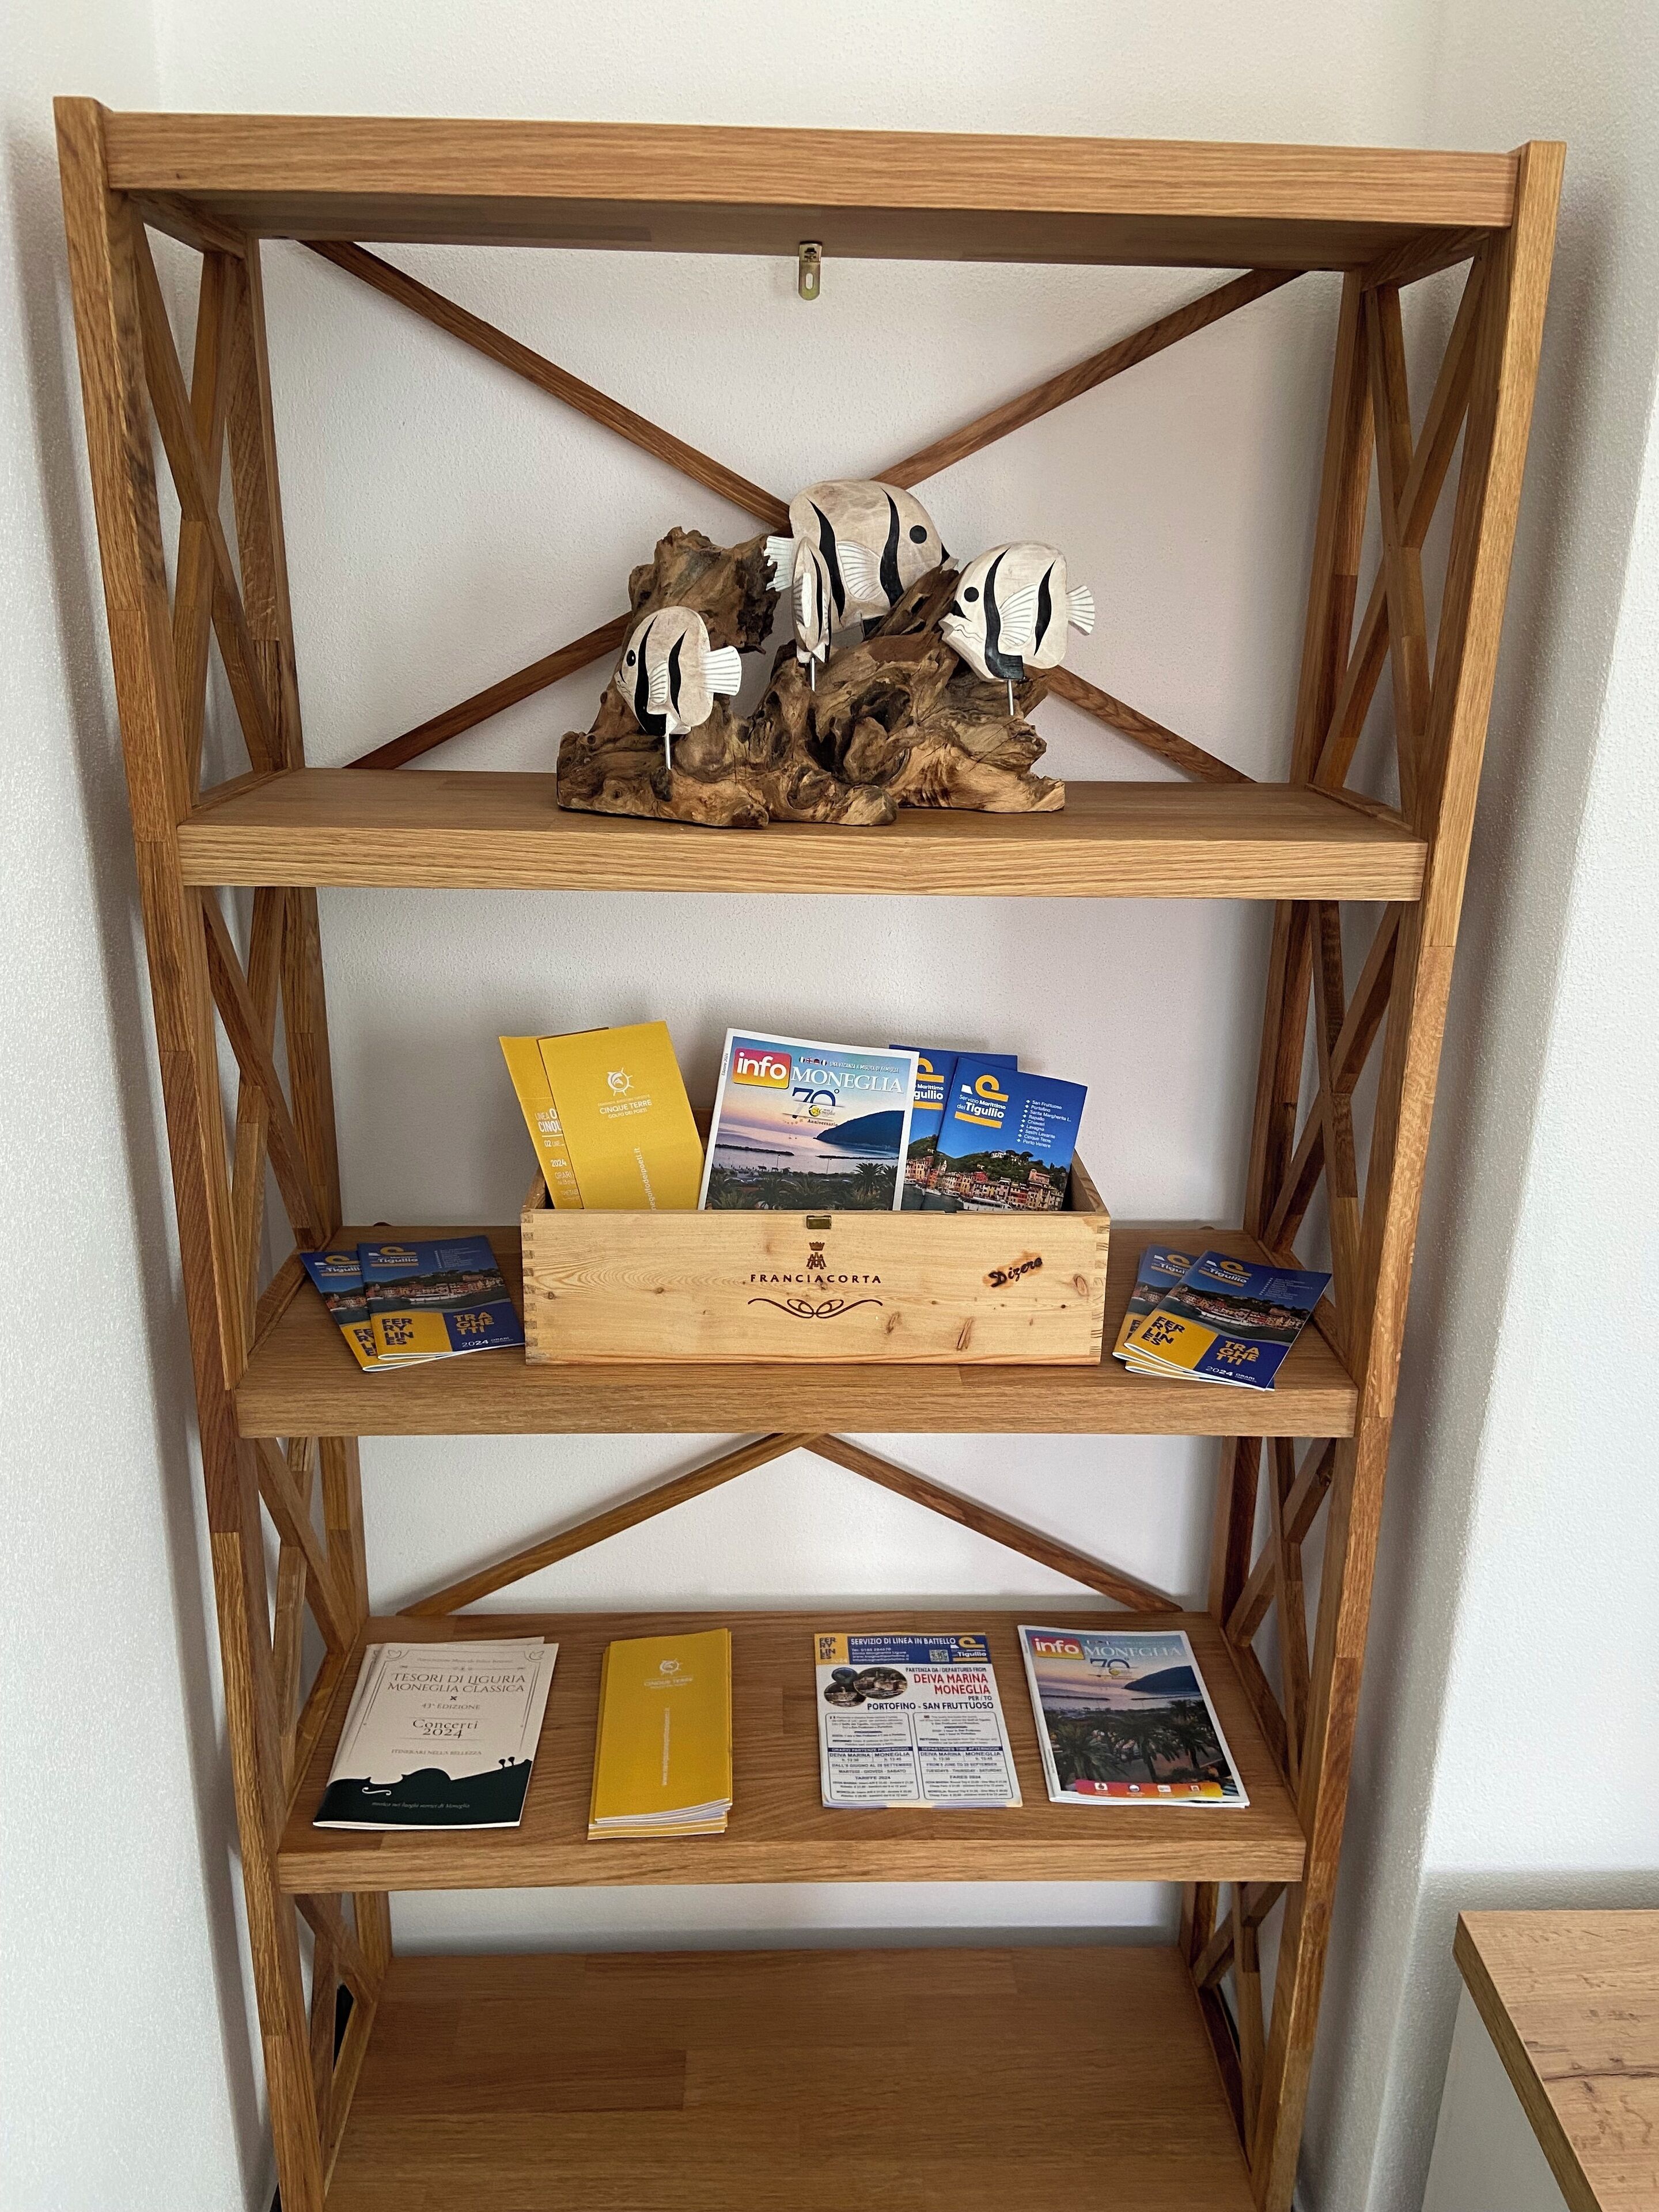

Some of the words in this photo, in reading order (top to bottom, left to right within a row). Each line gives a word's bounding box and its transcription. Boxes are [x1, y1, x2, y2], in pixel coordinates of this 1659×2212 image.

[737, 1052, 787, 1080] info
[791, 1066, 904, 1093] MONEGLIA
[914, 1090, 944, 1100] gullio
[600, 1104, 628, 1114] CINQUE
[628, 1099, 652, 1109] TERRE
[959, 1094, 979, 1104] Servizio
[979, 1100, 1006, 1109] Marittimo
[966, 1102, 1005, 1118] Tigullio
[1043, 1112, 1066, 1121] Margherita
[538, 1120, 562, 1133] CINQU
[551, 1159, 567, 1167] 2024
[751, 1274, 881, 1283] FRANCIACORTA
[1210, 1267, 1247, 1283] Tigullio
[453, 1312, 493, 1321] TRA
[1156, 1316, 1185, 1333] FER
[353, 1328, 373, 1337] FE
[1146, 1327, 1174, 1344] LIN
[387, 1337, 407, 1345] ES
[462, 1339, 488, 1347] 2024
[1141, 1332, 1162, 1346] ES
[1225, 1340, 1260, 1355] TRA
[1217, 1353, 1243, 1365] TTI
[1219, 1348, 1259, 1362] GHE
[1206, 1366, 1233, 1376] 2024
[1035, 1638, 1080, 1654] info
[1084, 1646, 1182, 1657] MONEGLIA
[392, 1673, 443, 1683] TESORI
[448, 1675, 464, 1683] DI
[468, 1674, 526, 1685] LIGURIA
[914, 1674, 944, 1683] DEIVA
[946, 1673, 988, 1683] MARINA
[387, 1682, 459, 1692] MONEGLIA
[463, 1684, 524, 1693] CLASSICA
[934, 1685, 991, 1694] MONEGLIA
[867, 1702, 916, 1710] PORTOFINO
[413, 1719, 479, 1729] Concerti
[423, 1728, 463, 1738] 2024
